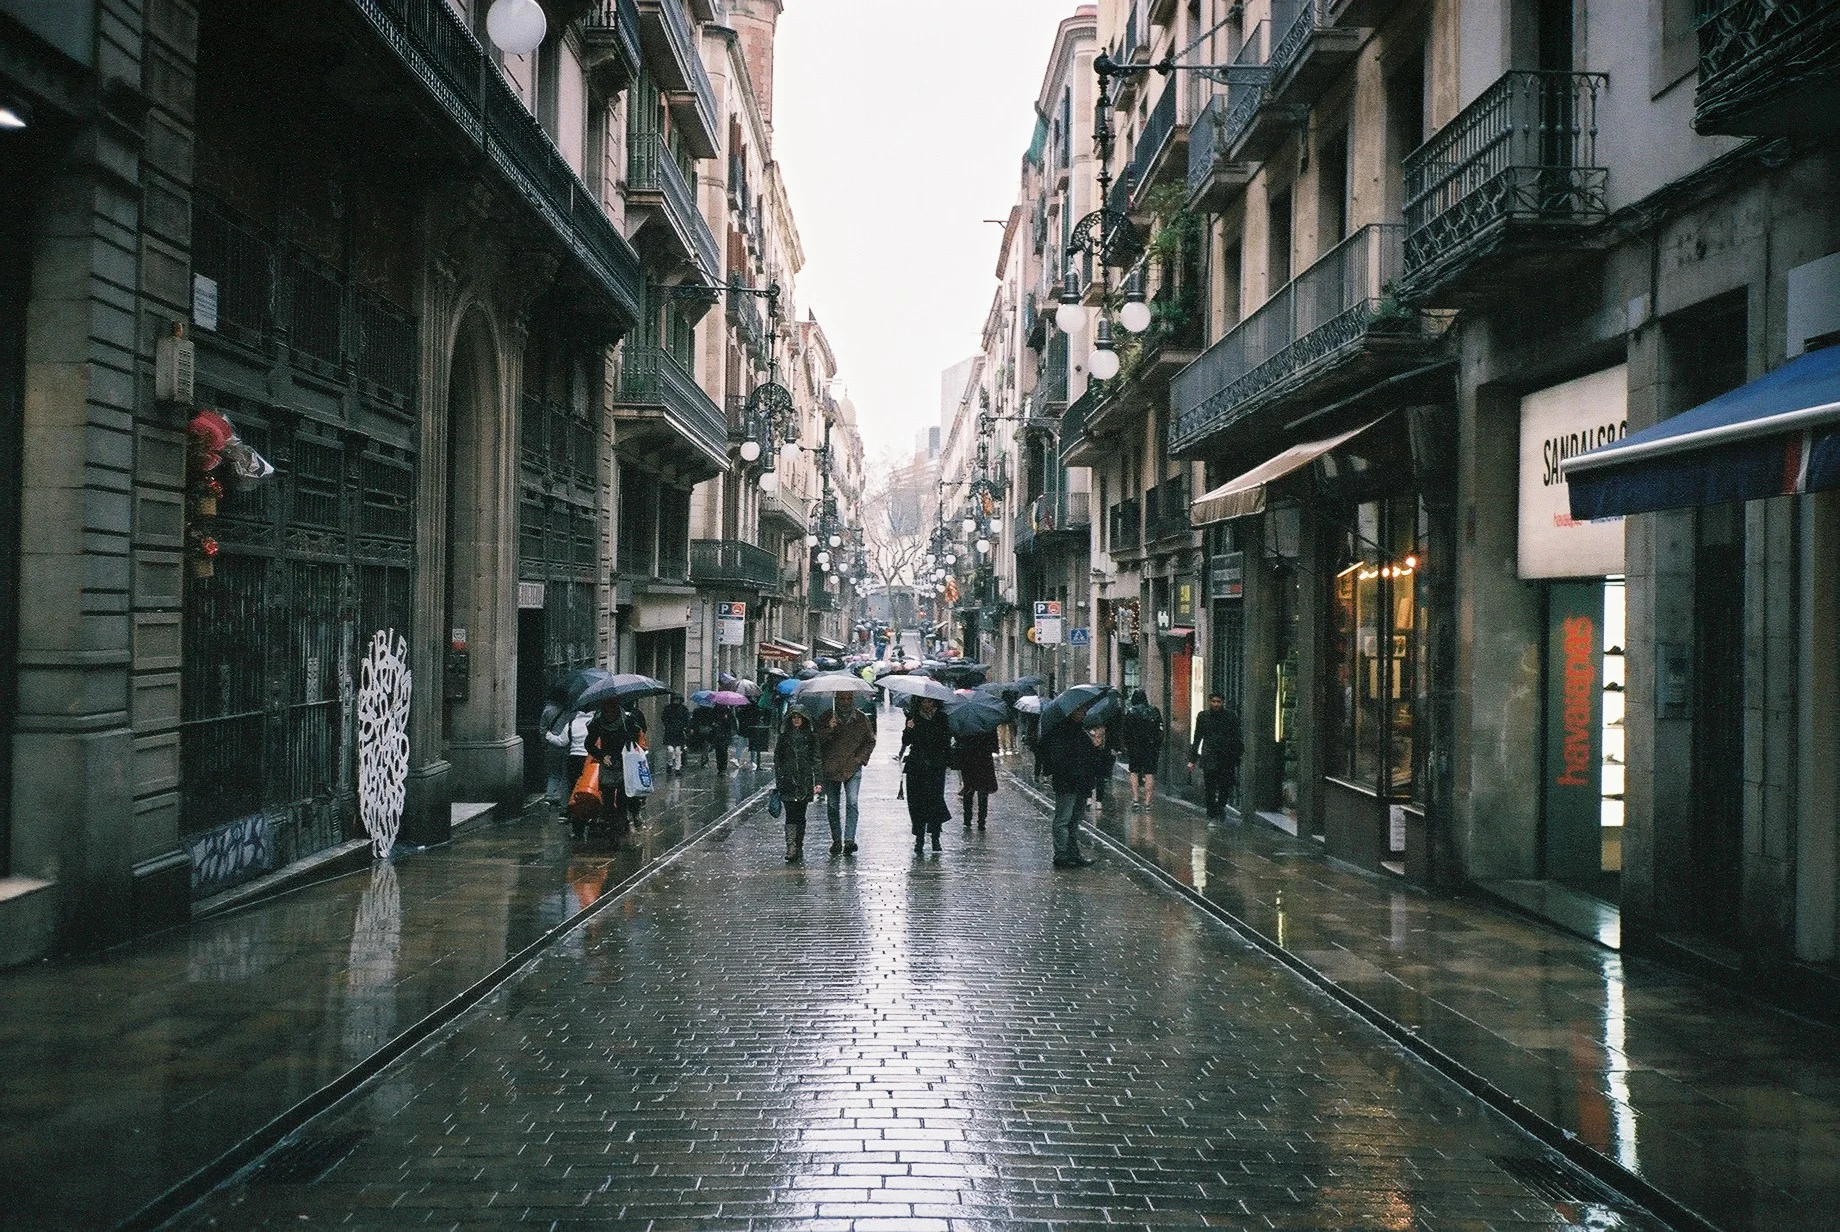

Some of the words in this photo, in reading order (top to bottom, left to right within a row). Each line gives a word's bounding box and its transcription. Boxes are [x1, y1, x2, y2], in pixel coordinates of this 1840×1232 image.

[721, 603, 729, 614] P
[1037, 603, 1046, 614] P
[1556, 615, 1596, 786] havaianas
